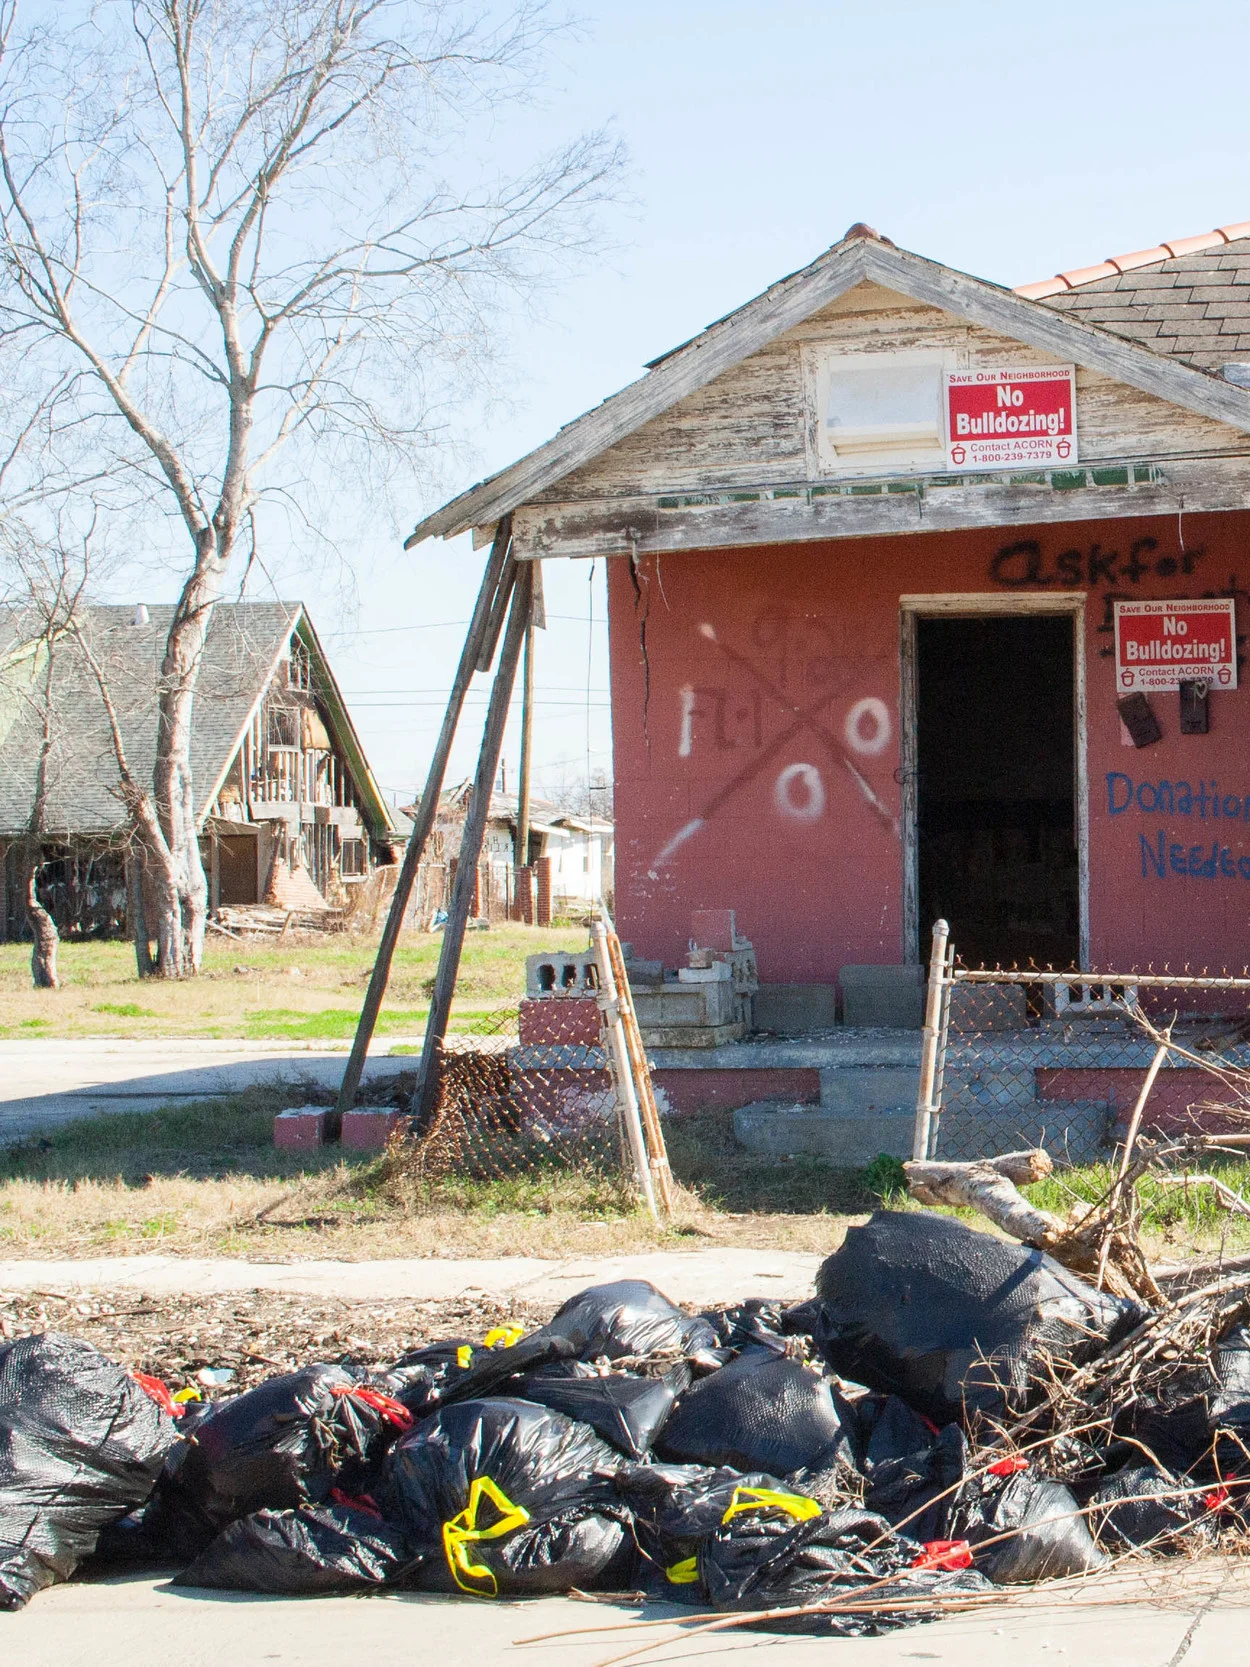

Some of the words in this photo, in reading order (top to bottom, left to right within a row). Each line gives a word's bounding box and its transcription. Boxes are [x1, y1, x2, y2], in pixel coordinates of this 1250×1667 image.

[949, 373, 973, 384] SAVE
[976, 372, 996, 382] OUR
[1000, 369, 1071, 380] NEIGHBORHOOD
[996, 385, 1024, 407] No
[956, 408, 1065, 436] Bulldozing!
[970, 442, 1010, 452] Contact
[1013, 439, 1053, 450] ACORN
[972, 451, 1052, 463] 1-800-239-7379
[1119, 605, 1140, 613] SAVE
[1144, 604, 1163, 613] OUR
[1166, 603, 1230, 612] NEIGHBORHOOD
[1163, 616, 1188, 636] No
[1126, 638, 1226, 663] Bulldozing!
[1139, 668, 1175, 676] Contact
[1178, 666, 1215, 675] ACORN
